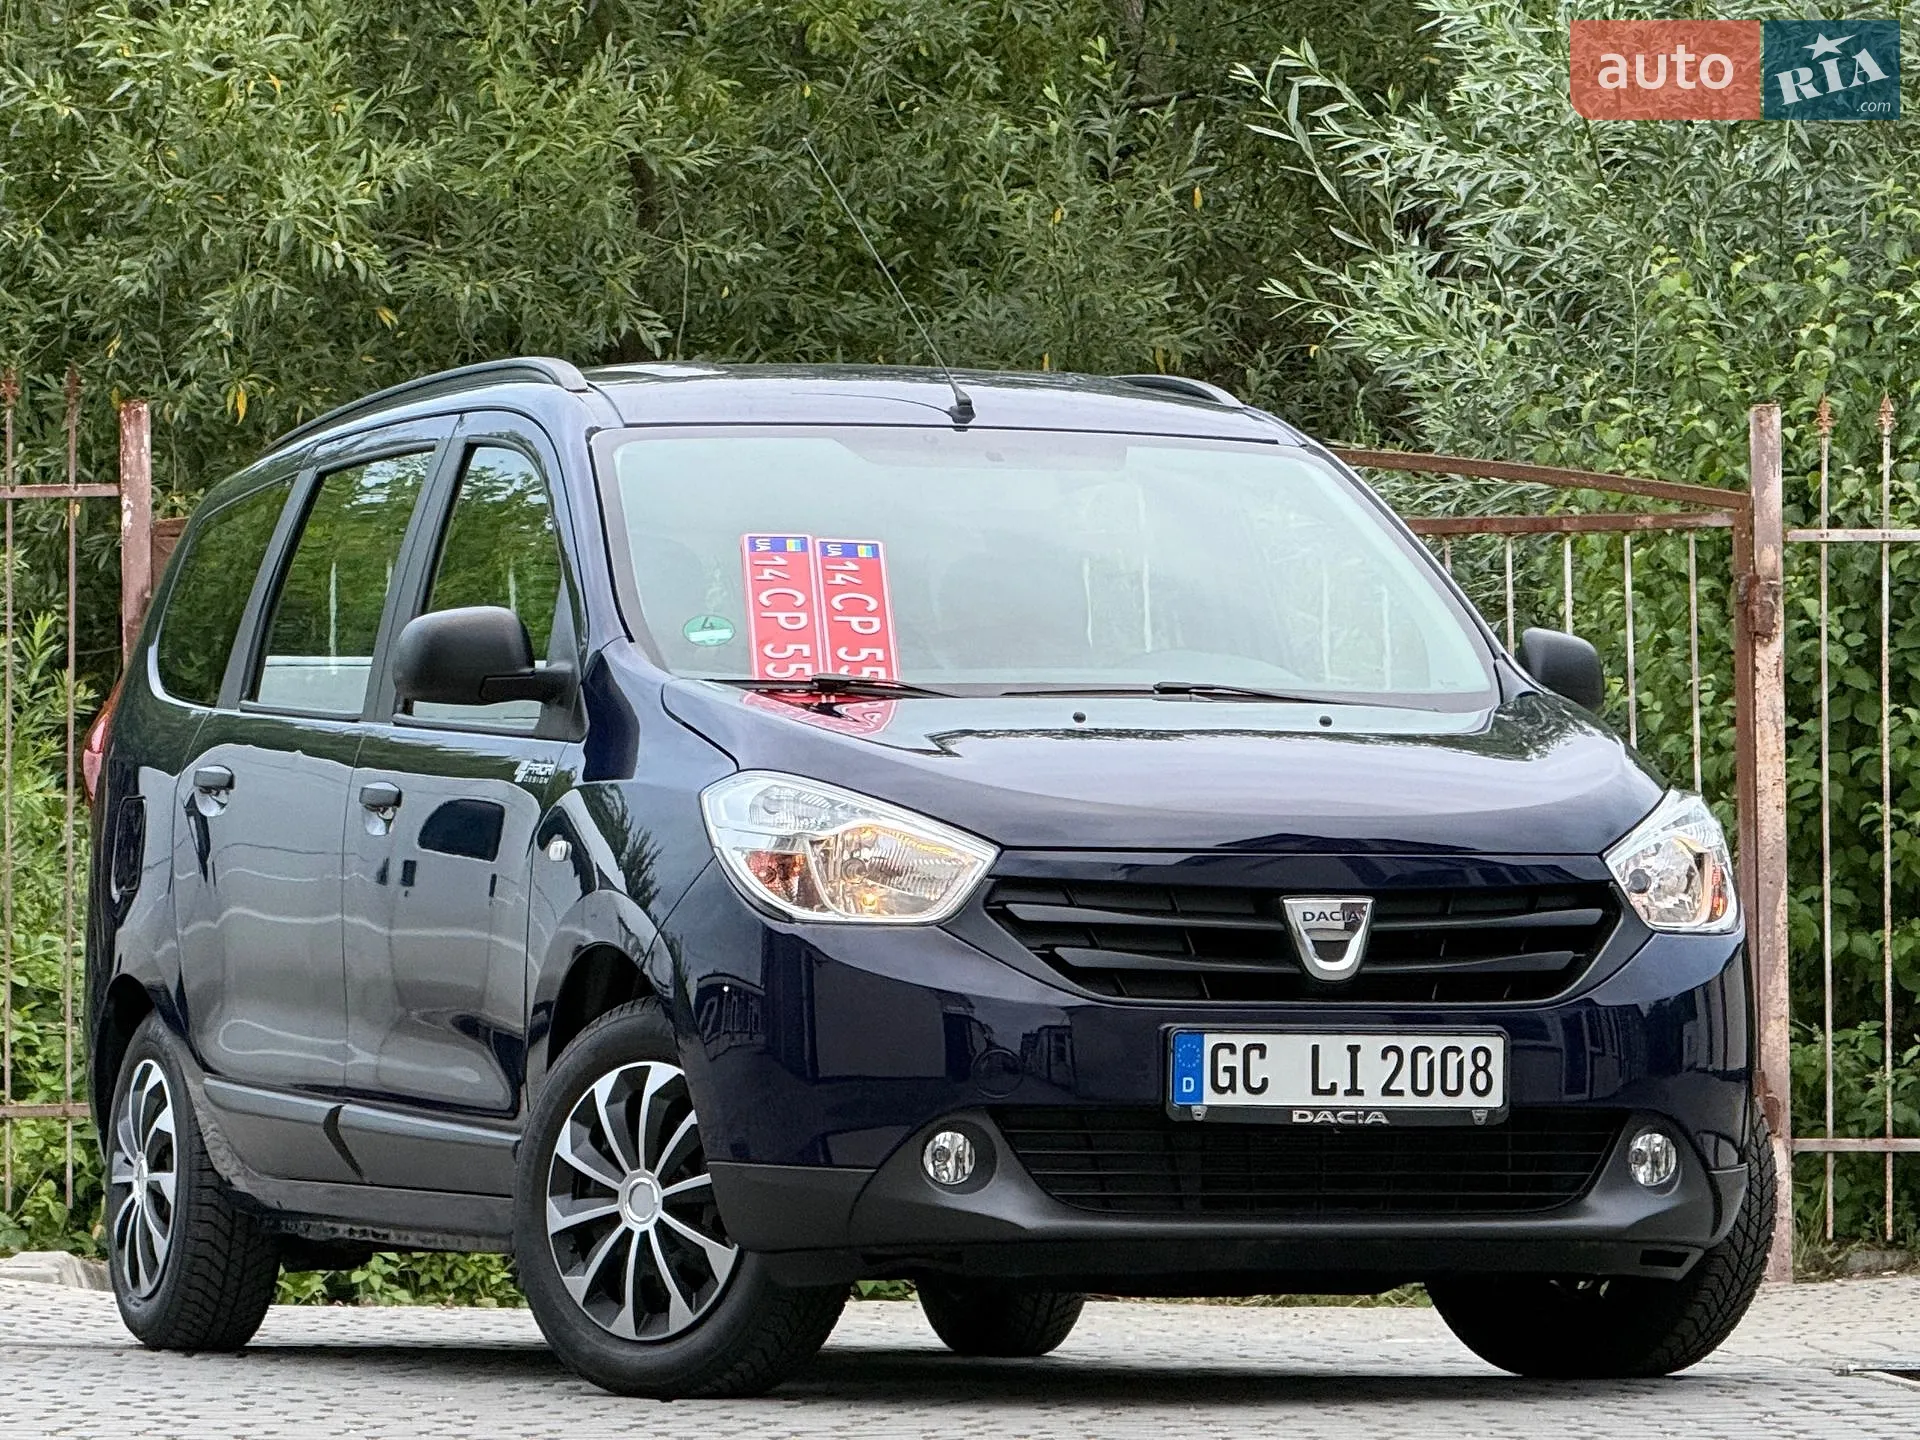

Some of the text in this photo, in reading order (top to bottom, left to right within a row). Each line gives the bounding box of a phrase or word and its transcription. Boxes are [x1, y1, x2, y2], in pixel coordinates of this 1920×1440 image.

[755, 539, 771, 551] UA
[827, 544, 842, 556] UA
[1302, 911, 1361, 921] DACIA
[1210, 1042, 1494, 1097] GC LI 2008
[1182, 1077, 1194, 1093] D
[1292, 1110, 1391, 1124] DACIA
